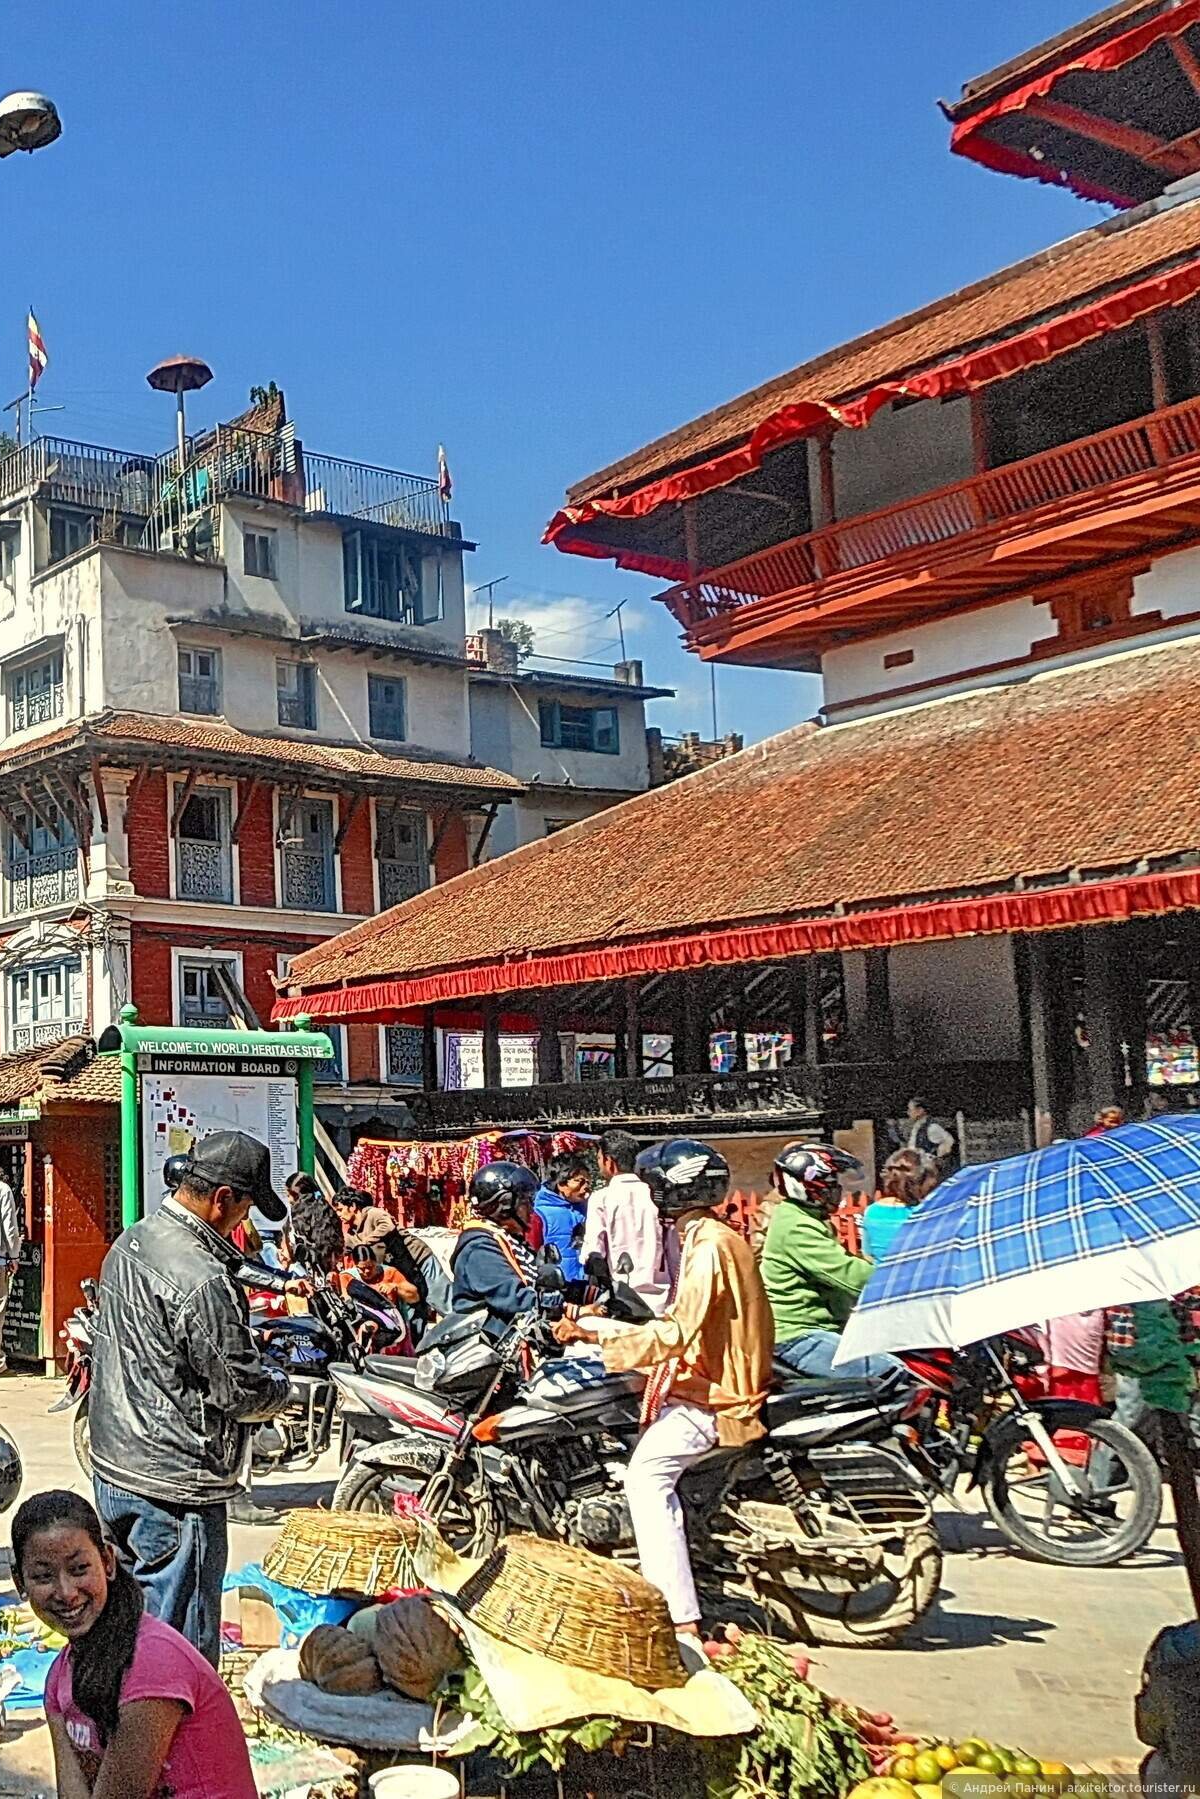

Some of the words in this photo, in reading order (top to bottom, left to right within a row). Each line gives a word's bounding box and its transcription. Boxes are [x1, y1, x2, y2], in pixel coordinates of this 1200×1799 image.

[138, 1041, 192, 1053] WELCOME
[193, 1042, 208, 1053] TO
[211, 1042, 249, 1055] WORLD
[251, 1044, 300, 1057] HERITAGE
[301, 1045, 324, 1057] SITE
[154, 1059, 236, 1073] INFORMATION
[241, 1062, 280, 1074] BOARD
